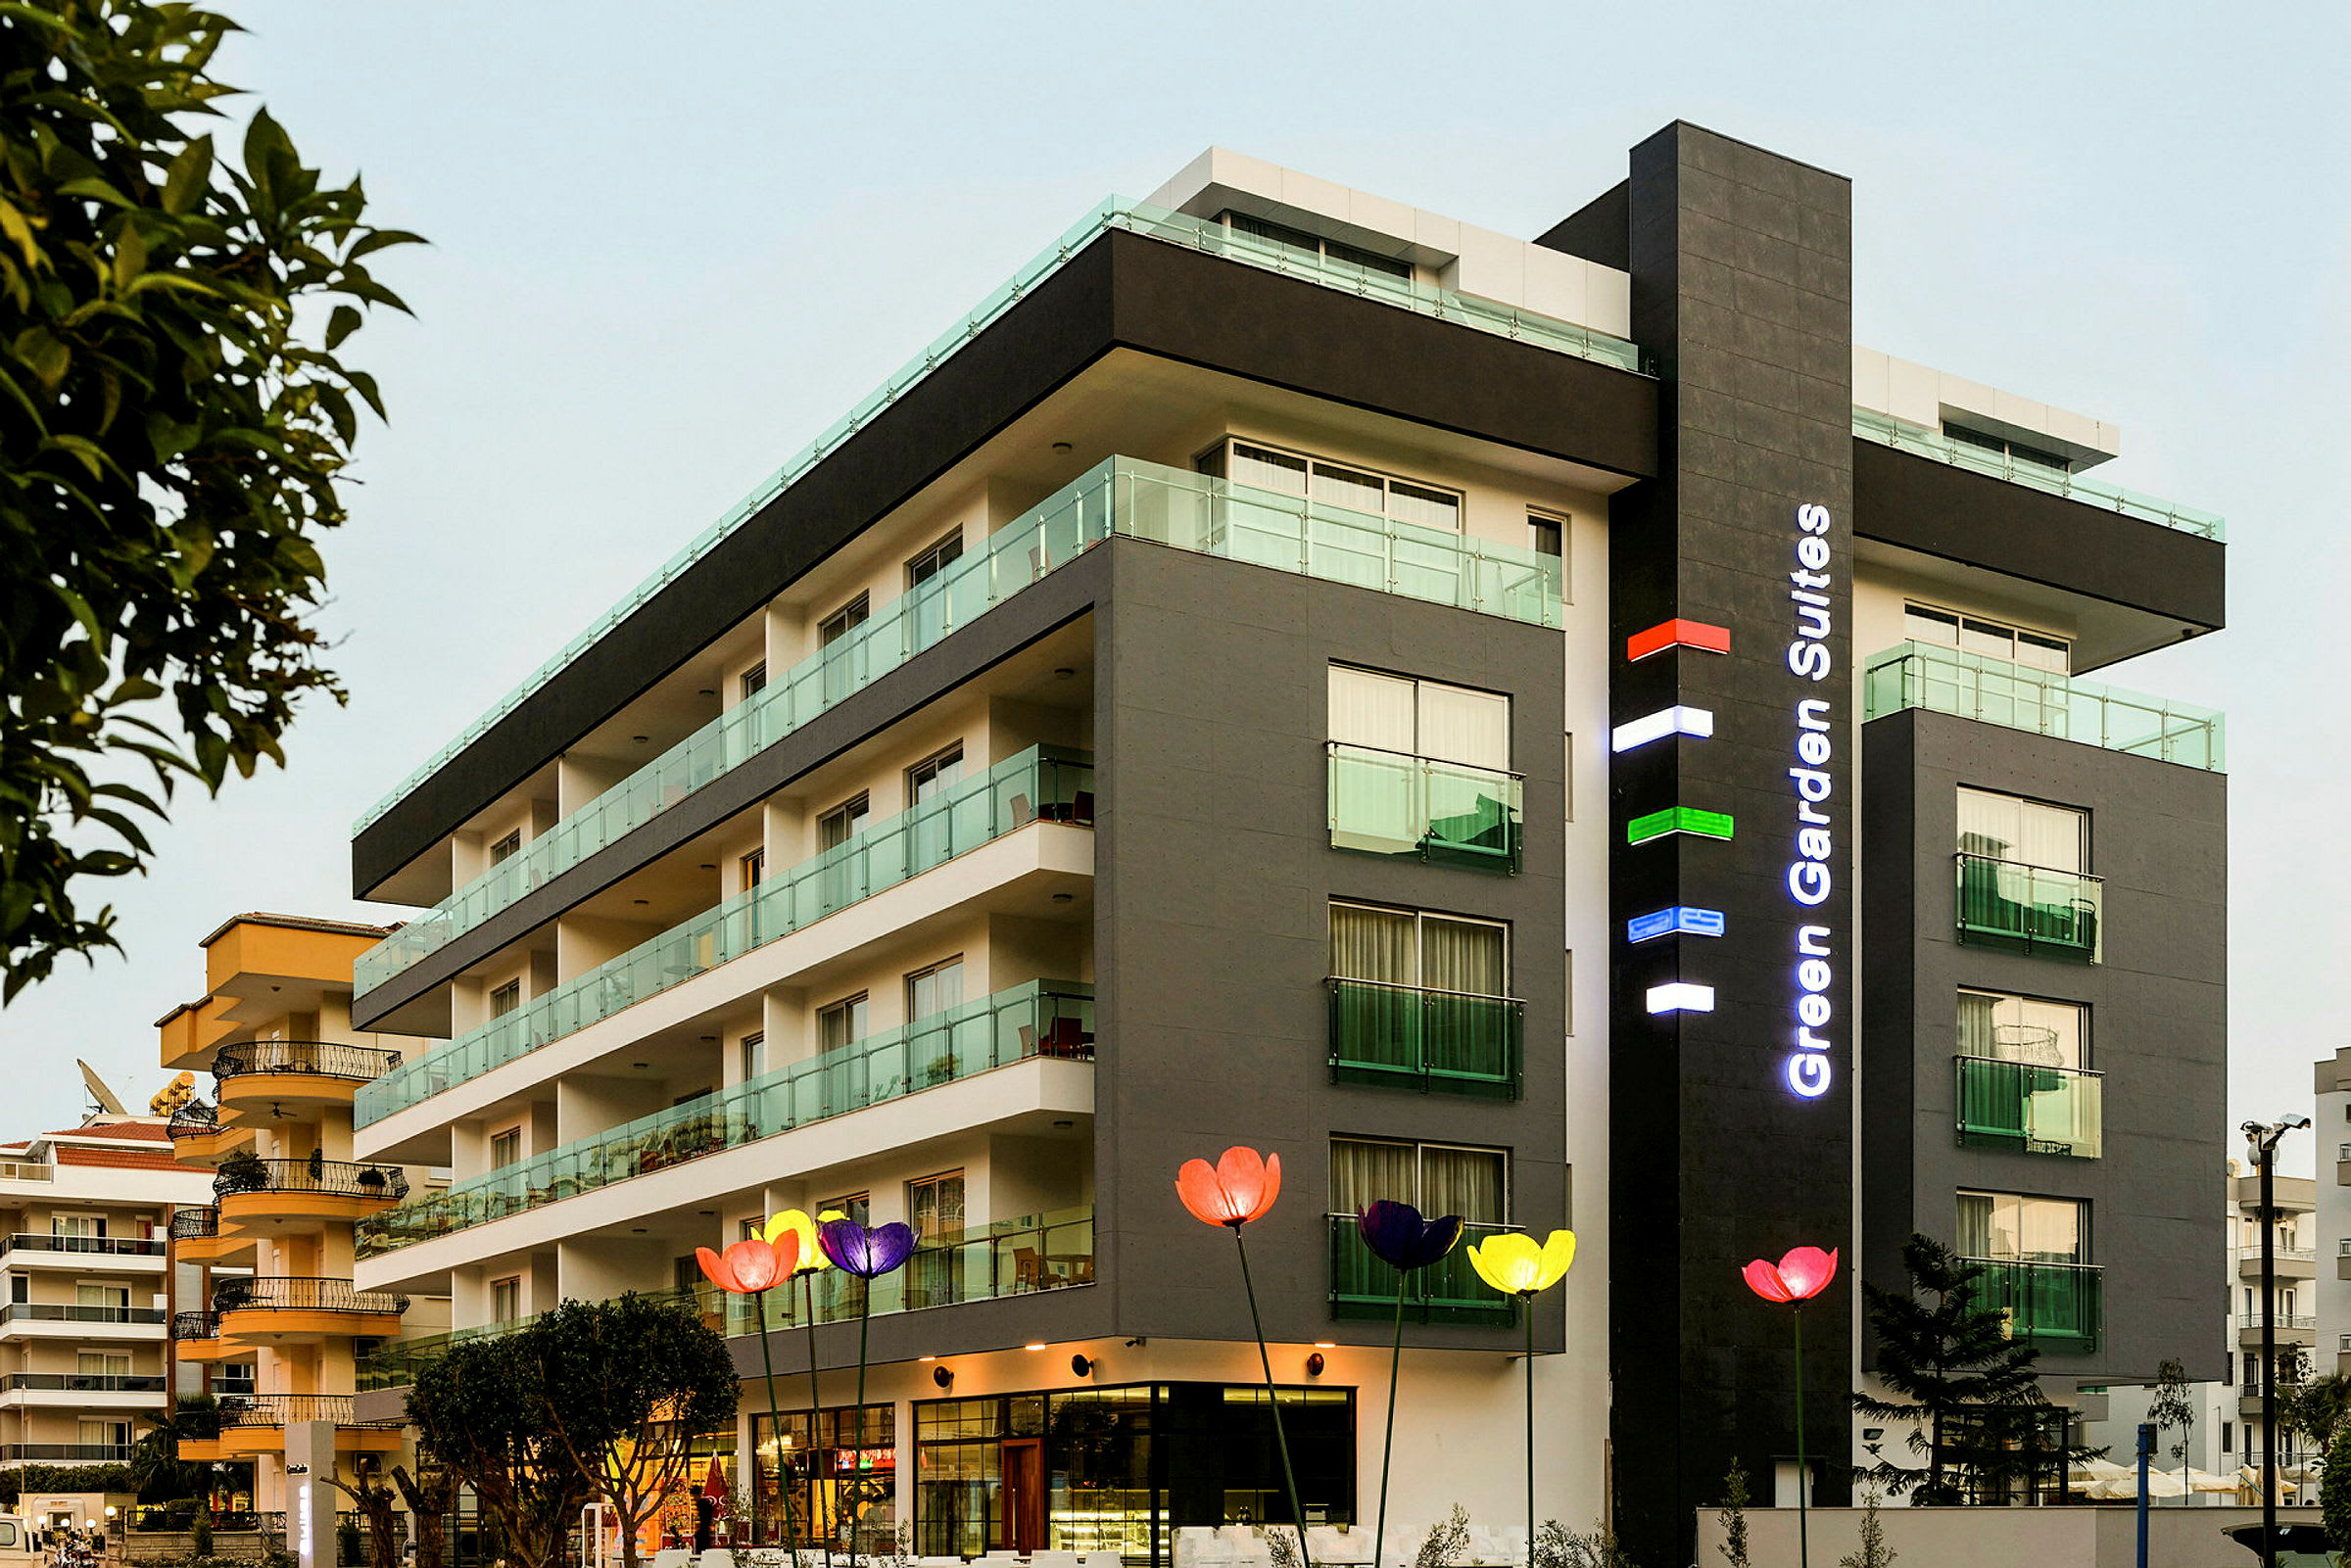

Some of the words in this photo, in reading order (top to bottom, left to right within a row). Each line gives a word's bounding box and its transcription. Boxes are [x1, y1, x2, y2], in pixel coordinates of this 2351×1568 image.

[1788, 502, 1831, 681] Suites
[1788, 698, 1831, 906] Garden
[1787, 925, 1831, 1097] Green
